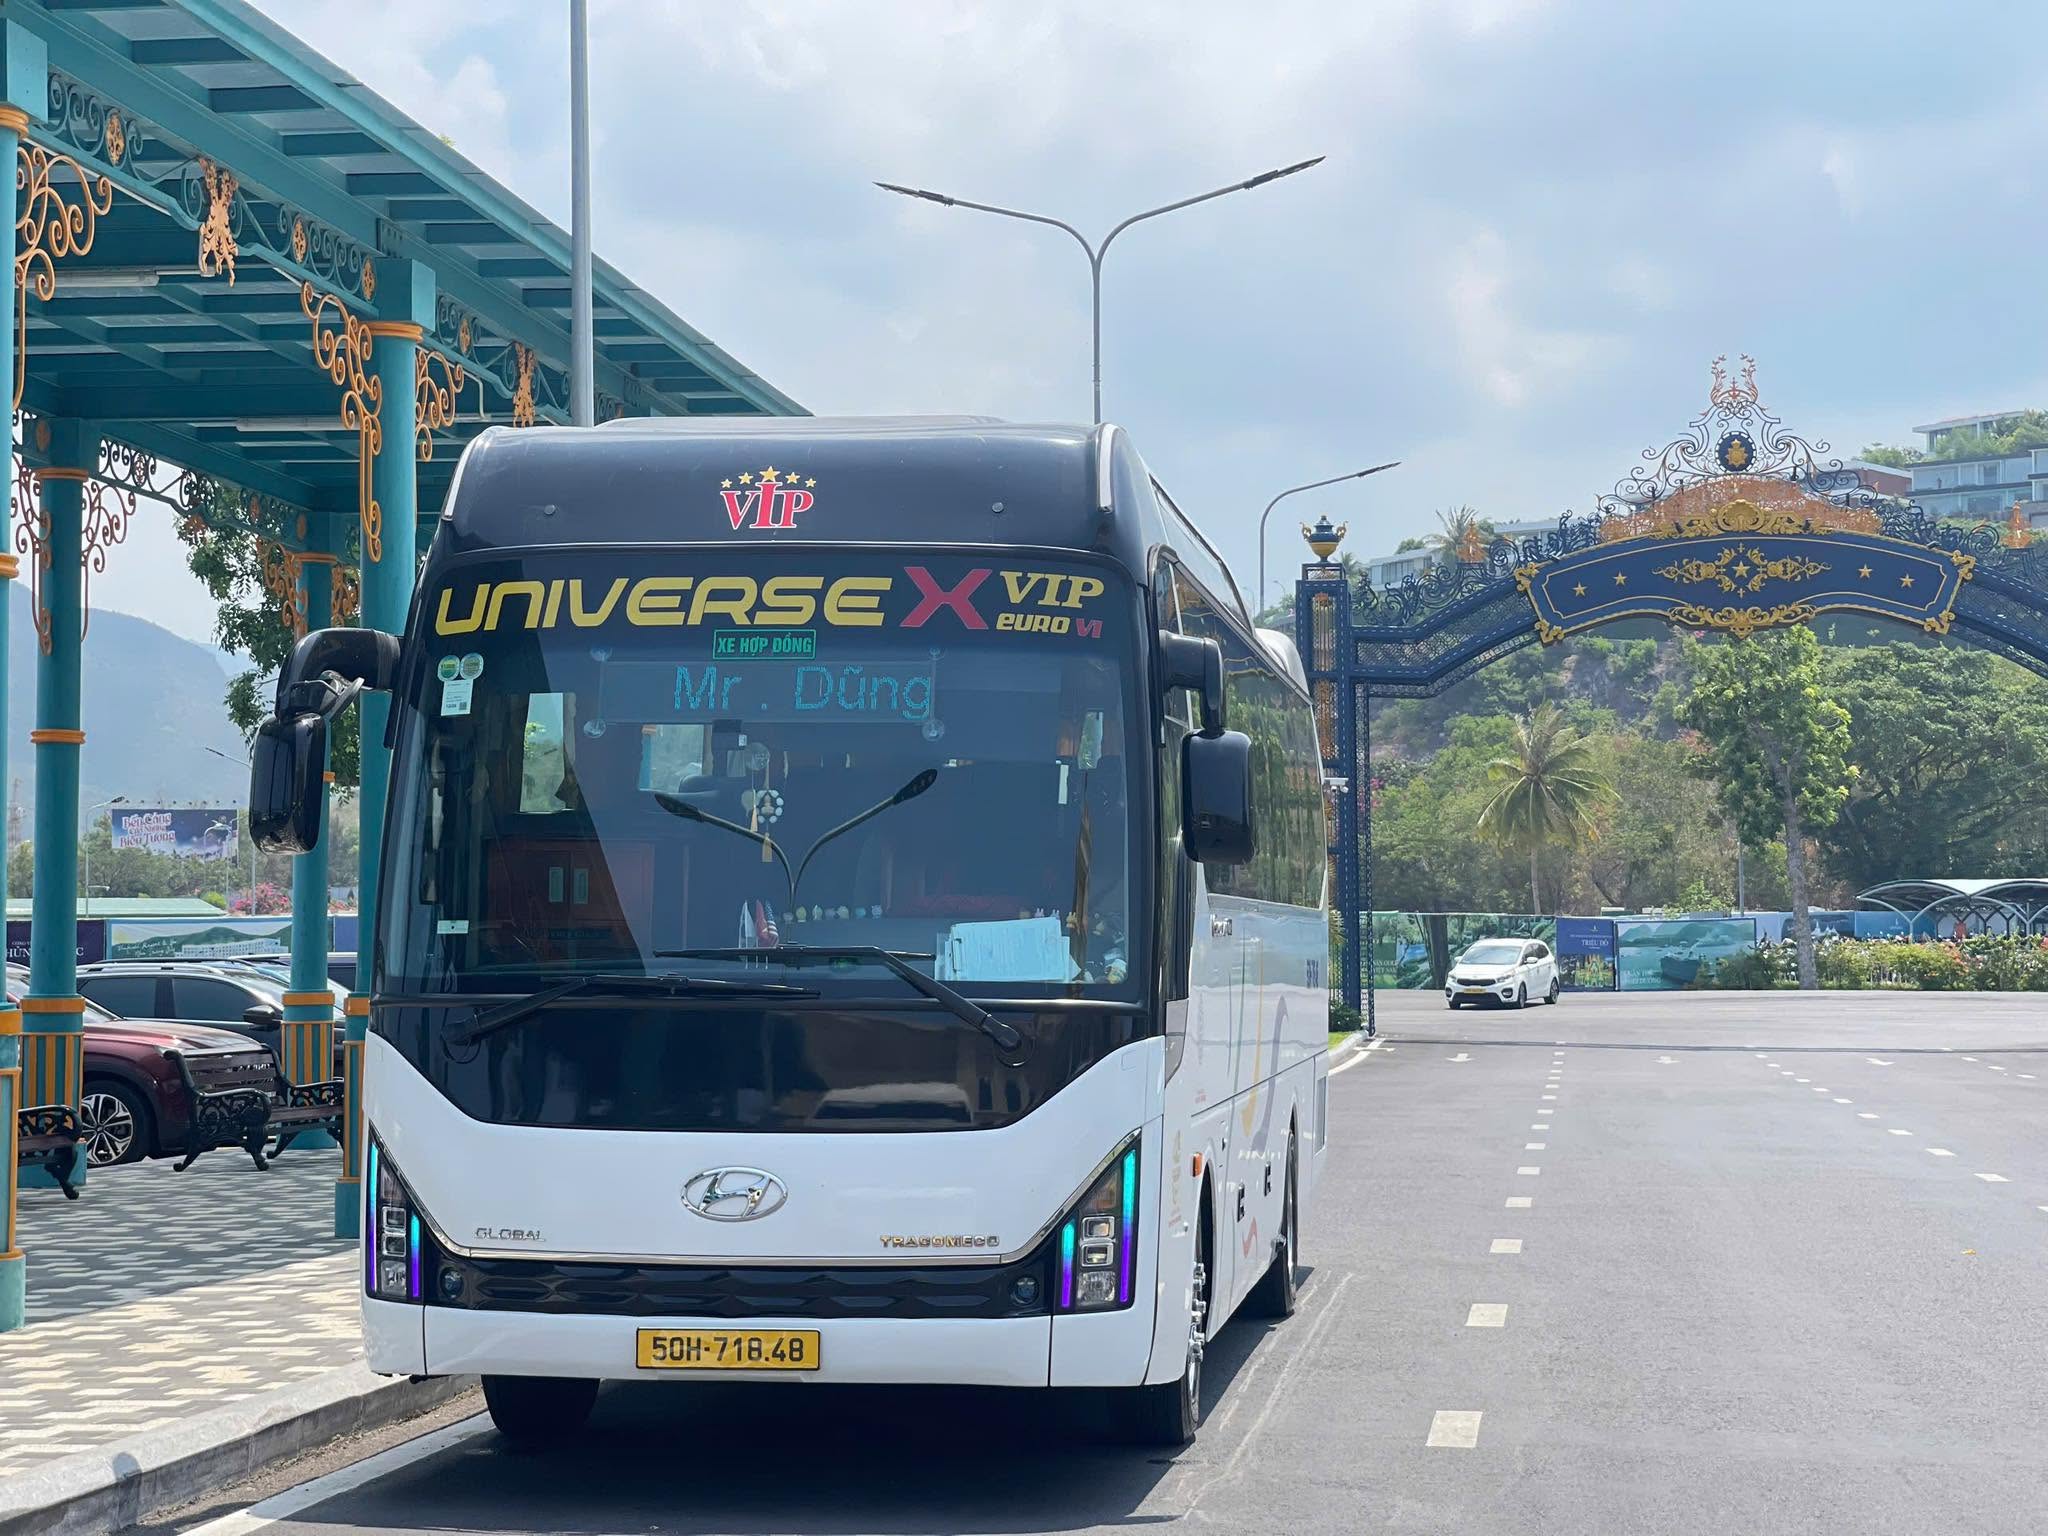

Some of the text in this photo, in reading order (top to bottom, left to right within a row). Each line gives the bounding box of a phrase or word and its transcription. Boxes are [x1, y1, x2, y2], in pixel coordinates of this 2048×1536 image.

[720, 482, 814, 530] VIP
[435, 566, 993, 636] UNIVERSE X
[1000, 570, 1105, 609] VIP
[1075, 617, 1104, 639] VI
[717, 637, 735, 653] XE
[739, 634, 768, 656] HỢP
[795, 666, 930, 719] Dũng
[475, 1227, 546, 1242] GLOBAL
[880, 1235, 999, 1248] TRACOMECO
[652, 1336, 804, 1362] 50H-718.48
